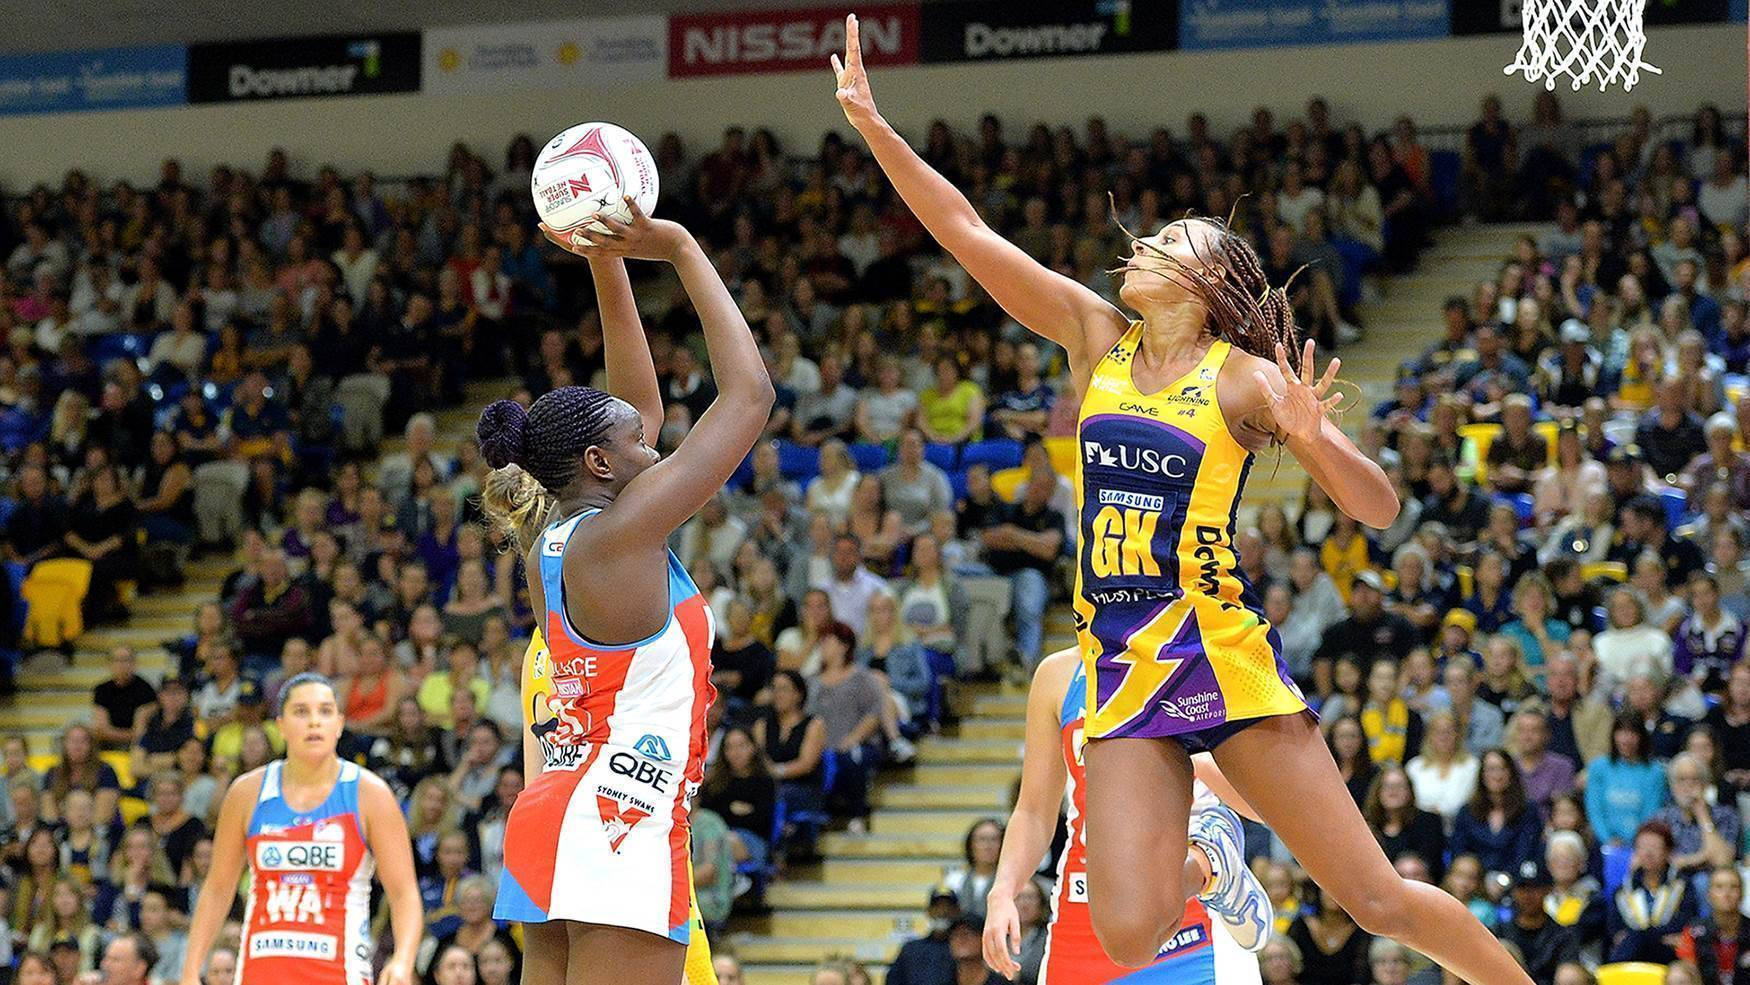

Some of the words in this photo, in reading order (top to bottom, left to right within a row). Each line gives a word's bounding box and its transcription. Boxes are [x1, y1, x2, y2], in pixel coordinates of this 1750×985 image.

[684, 17, 901, 64] NISSAN
[964, 22, 1107, 56] Downer
[228, 64, 358, 97] Downer
[547, 187, 569, 204] SUPER
[1118, 444, 1186, 478] USC
[1100, 490, 1162, 509] SAMSUNG
[1091, 505, 1162, 579] GK
[1177, 691, 1219, 707] Sunshine
[1185, 702, 1209, 716] Coast
[1196, 709, 1226, 721] AIRPORT
[609, 752, 673, 793] QBE
[597, 785, 627, 801] SYDNEY
[629, 796, 655, 813] SWANS
[287, 845, 336, 868] QBE
[265, 880, 325, 924] WA
[255, 938, 330, 954] SAMSUNG
